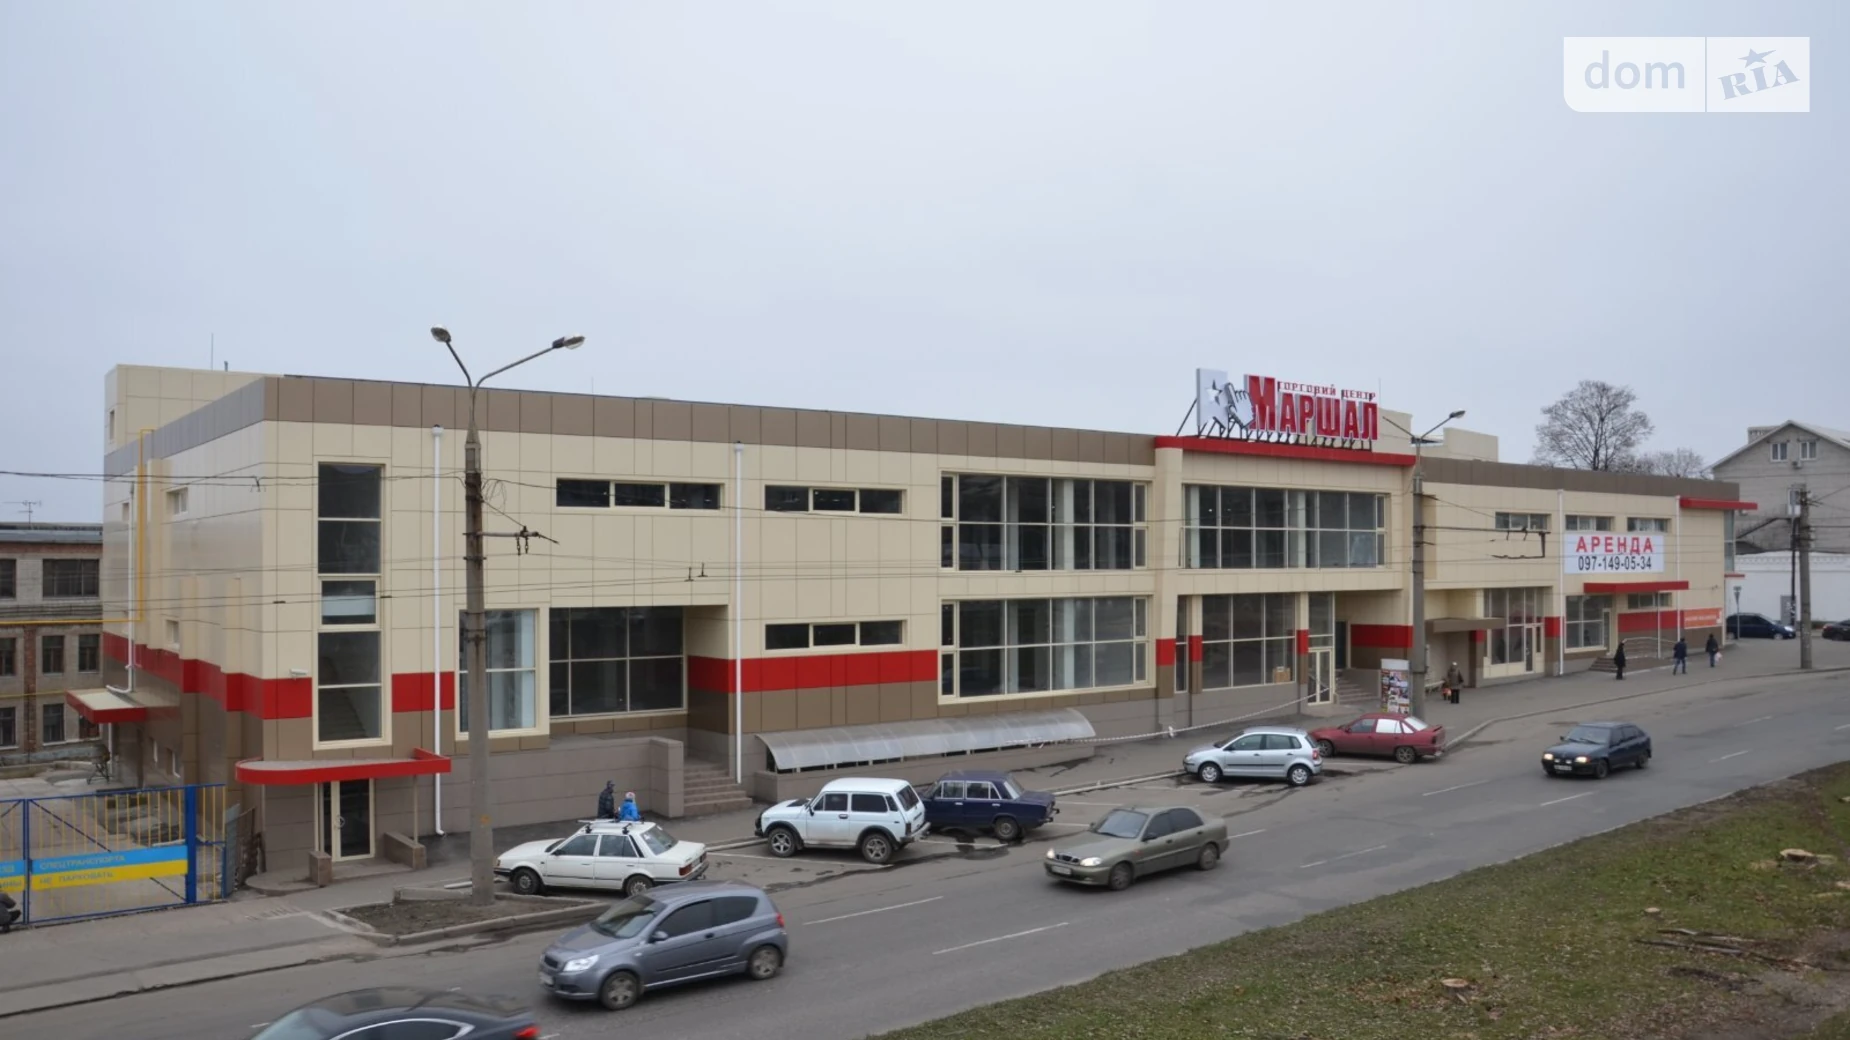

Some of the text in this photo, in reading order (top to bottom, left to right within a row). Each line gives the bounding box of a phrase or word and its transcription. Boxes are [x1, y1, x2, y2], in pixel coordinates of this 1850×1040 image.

[1277, 380, 1376, 400] ТОРГОВИЙ ЦЕНТР
[1245, 374, 1378, 441] МАРШАЛ
[1576, 536, 1653, 555] АРЕНДА
[1578, 556, 1652, 571] 097-149-05-34
